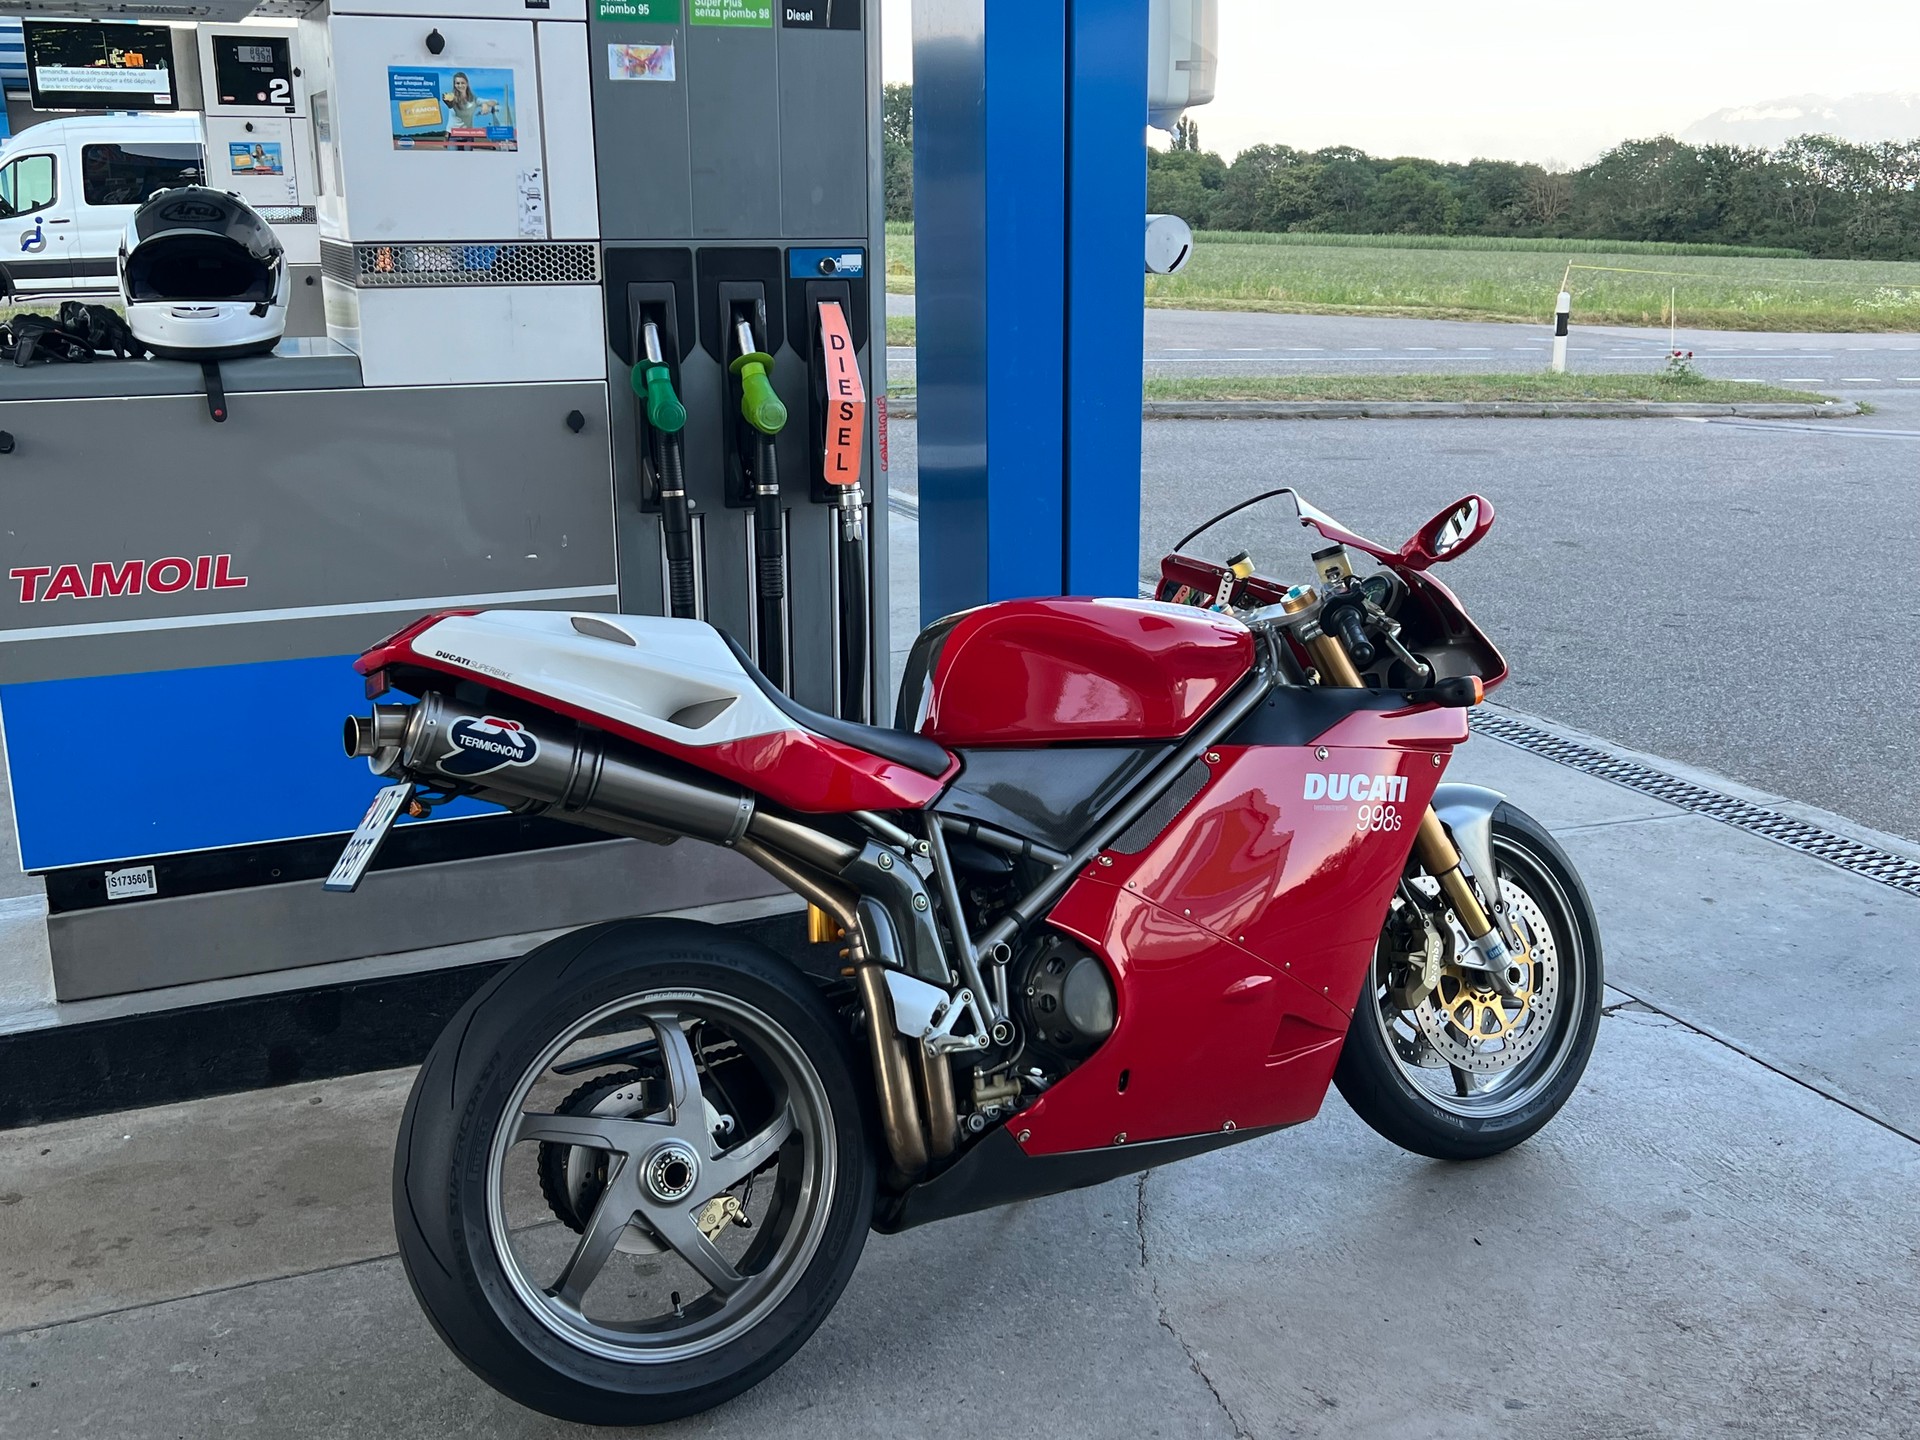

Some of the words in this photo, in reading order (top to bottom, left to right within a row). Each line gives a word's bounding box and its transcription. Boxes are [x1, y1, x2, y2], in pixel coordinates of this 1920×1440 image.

[600, 2, 636, 15] piombo
[638, 4, 650, 15] 95
[695, 8, 721, 17] senza
[723, 7, 757, 20] piombo
[758, 8, 770, 19] 98
[786, 9, 813, 21] Diesel
[269, 78, 291, 104] 2
[163, 202, 219, 217] Arai
[829, 334, 854, 472] DIESEL
[9, 554, 249, 603] TAMOIL
[435, 650, 471, 666] DUCATI
[471, 660, 514, 679] SUPERBIKE
[459, 734, 524, 760] TERMIGNONI
[1303, 773, 1409, 803] DUCATI
[1356, 804, 1402, 832] 998s
[110, 873, 147, 888] S173560
[1428, 940, 1440, 982] brembo
